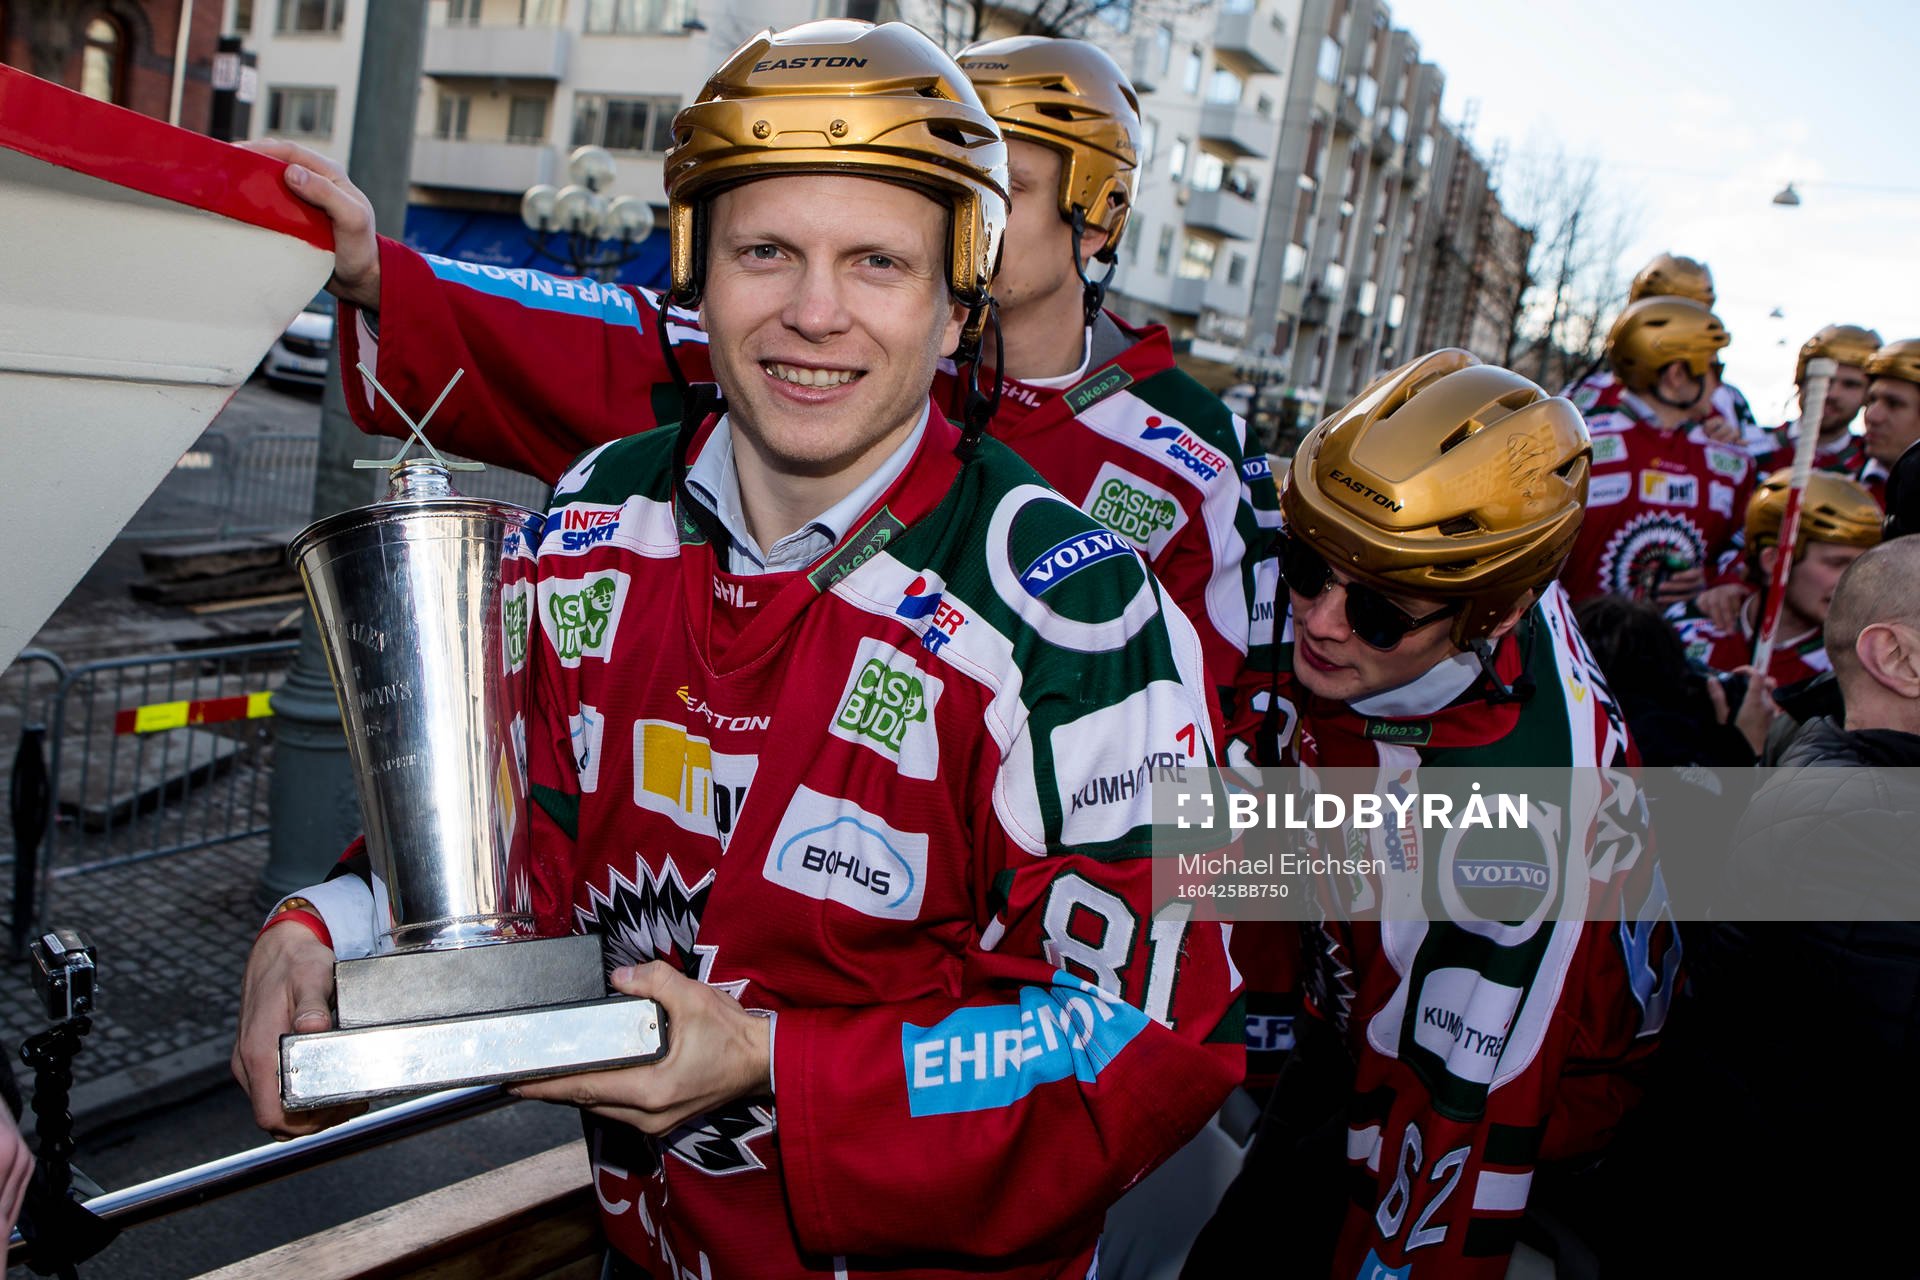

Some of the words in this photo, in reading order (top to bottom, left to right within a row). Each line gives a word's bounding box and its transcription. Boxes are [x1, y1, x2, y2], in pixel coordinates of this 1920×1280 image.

[753, 56, 868, 73] EASTON
[1078, 380, 1109, 406] akea
[1166, 444, 1218, 482] SPORT
[1176, 433, 1227, 472] INTER
[1104, 481, 1158, 521] CASH
[1330, 469, 1403, 513] EASTON
[562, 523, 620, 550] SPORT
[1094, 498, 1152, 541] BUDD
[857, 664, 909, 706] CAS
[687, 696, 771, 731] EATON
[1371, 722, 1408, 736] akea
[802, 845, 890, 895] BOHUS
[1458, 865, 1547, 886] VOLVO
[1043, 870, 1194, 1031] 81
[1375, 1121, 1472, 1252] 62
